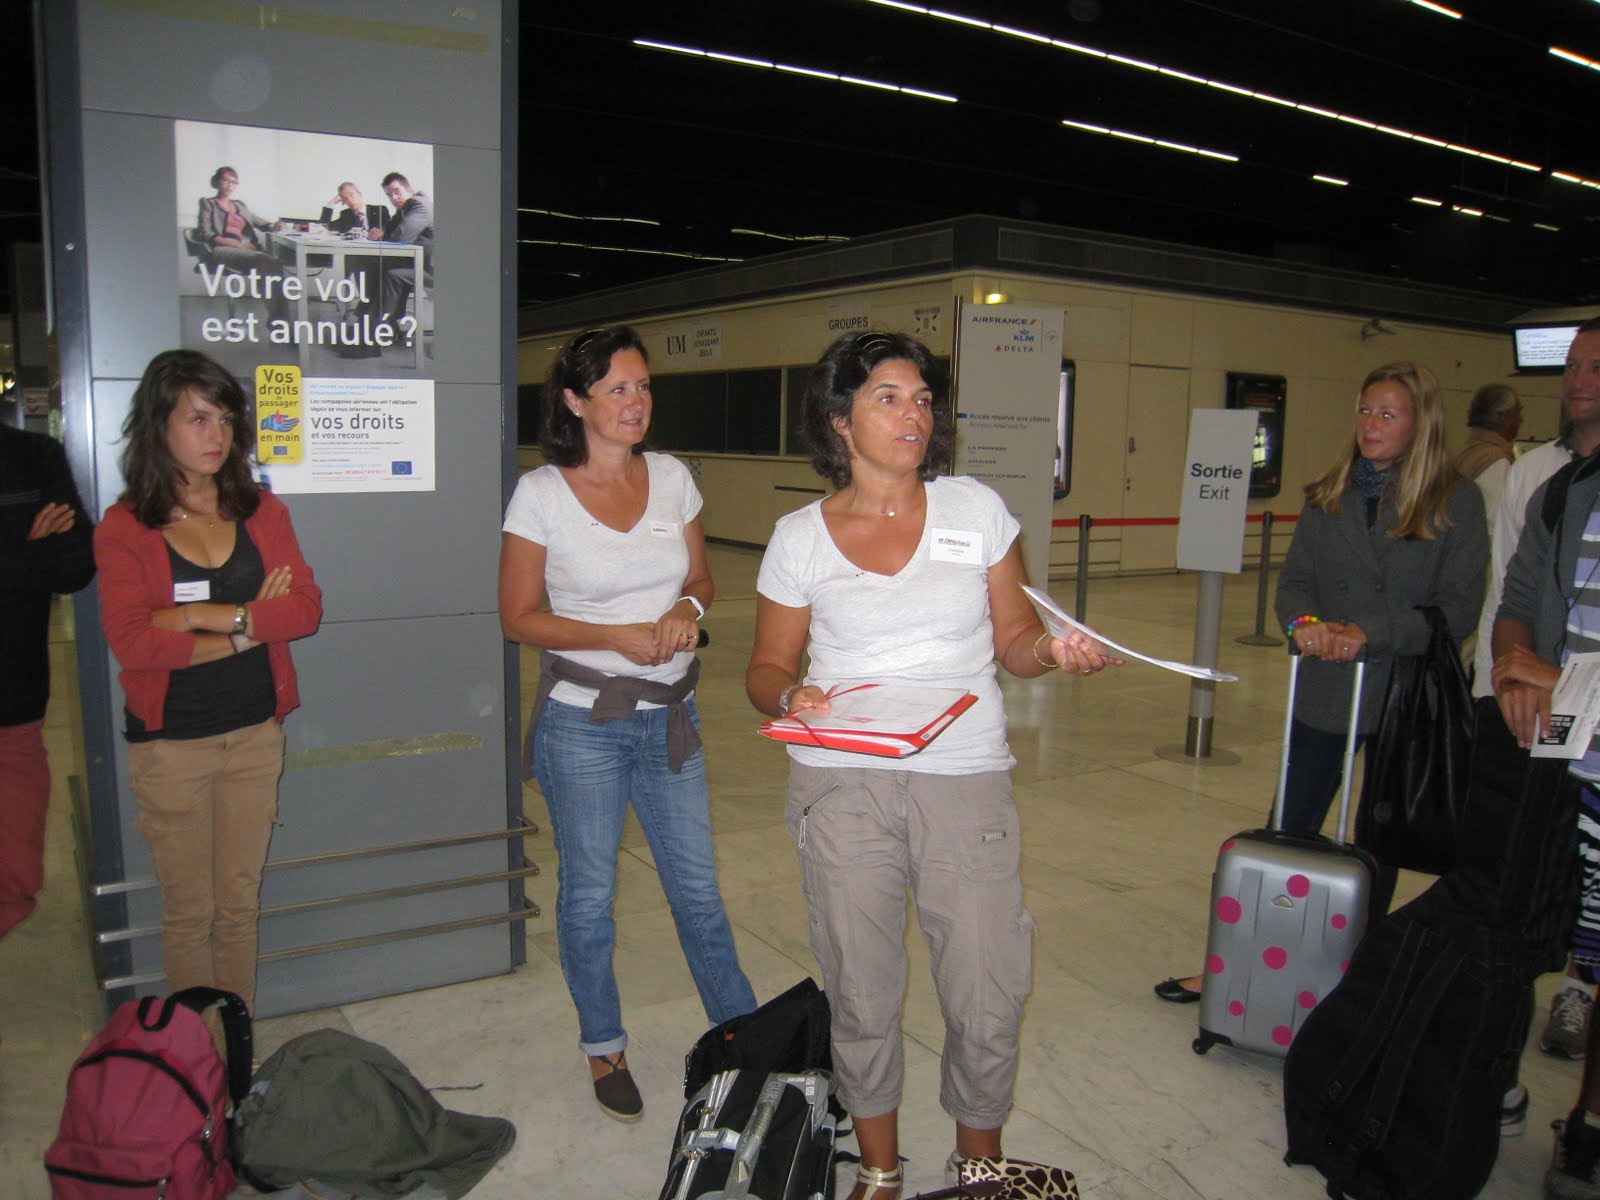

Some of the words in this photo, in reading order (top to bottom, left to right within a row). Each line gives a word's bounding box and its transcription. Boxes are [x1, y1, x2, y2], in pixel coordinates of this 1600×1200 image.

[199, 263, 302, 300] Votre
[315, 272, 370, 303] vol
[202, 313, 259, 342] est
[829, 316, 869, 330] GROUPES
[667, 335, 687, 355] UM
[263, 368, 294, 383] Vos
[259, 384, 298, 395] droits
[259, 400, 298, 408] passager
[311, 416, 344, 429] vos
[350, 413, 405, 429] droits
[1190, 463, 1243, 479] Sortie
[1199, 484, 1230, 500] Exit
